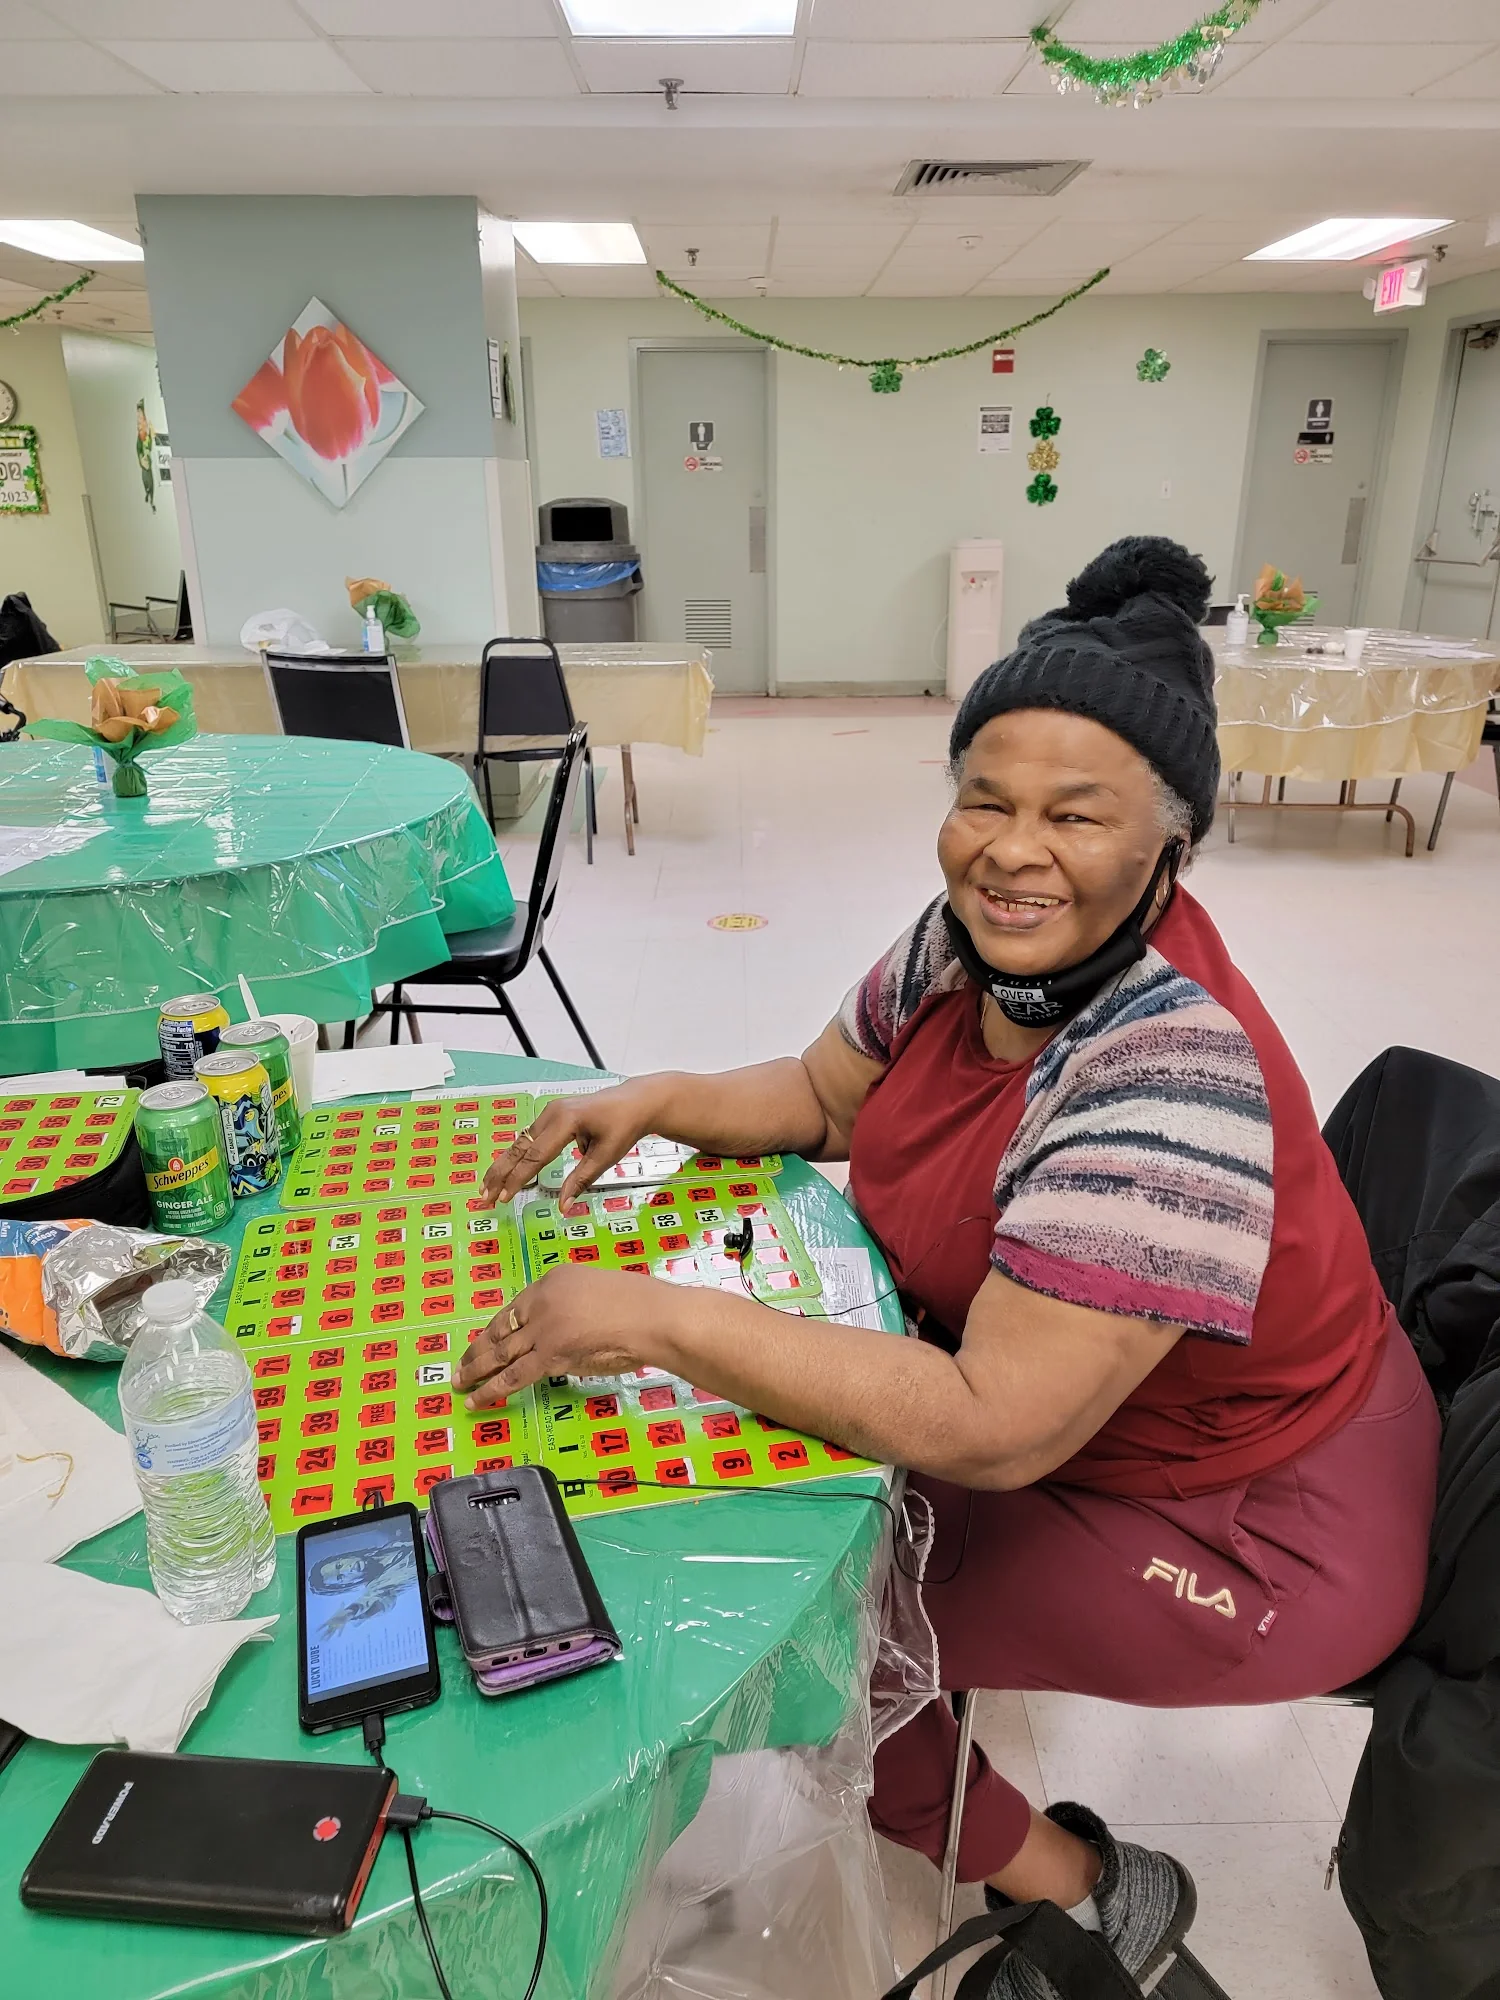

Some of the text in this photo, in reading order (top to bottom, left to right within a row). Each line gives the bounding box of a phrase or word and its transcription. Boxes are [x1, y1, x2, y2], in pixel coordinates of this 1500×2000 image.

[1380, 268, 1404, 306] EXIT
[1, 491, 29, 502] 2023
[1000, 989, 1035, 1001] OVER
[101, 1096, 119, 1107] 73
[380, 1126, 396, 1136] 51
[459, 1120, 475, 1129] 57
[310, 1132, 325, 1140] G
[305, 1149, 321, 1158] N
[457, 1154, 473, 1164] 28
[22, 1157, 44, 1169] 30
[331, 1164, 349, 1175] 25
[374, 1161, 391, 1171] 19
[415, 1156, 432, 1168] 30
[153, 1158, 209, 1189] Schweppes
[455, 1172, 472, 1183] 15
[551, 1169, 564, 1178] B
[294, 1187, 310, 1197] B
[694, 1160, 719, 1222] 54 73 9
[737, 1183, 755, 1198] 65
[156, 1195, 214, 1210] GINGER ALE
[474, 1219, 492, 1233] 58
[615, 1221, 633, 1233] 51
[652, 1193, 680, 1249] FREE 58 63
[257, 1224, 275, 1235] O
[535, 1208, 559, 1265] N G O
[476, 1240, 493, 1254] 42
[571, 1224, 594, 1261] 37 46
[621, 1241, 638, 1255] 44
[252, 1246, 271, 1258] G
[428, 1203, 449, 1309] 2 21 31 57 70
[327, 1213, 357, 1324] 6 27 37 54 66
[379, 1208, 402, 1319] 15 19 FREE 59 69
[477, 1264, 496, 1279] 24
[248, 1269, 267, 1283] N
[280, 1289, 300, 1305] 16
[479, 1289, 498, 1305] 14
[236, 1323, 256, 1338] B
[371, 1341, 391, 1359] 75
[423, 1335, 443, 1352] 64
[262, 1358, 284, 1376] 71
[423, 1366, 444, 1383] 57
[369, 1371, 390, 1390] 53
[258, 1387, 281, 1407] 59
[423, 1395, 445, 1415] 43
[370, 1404, 384, 1423] FREE
[540, 1383, 556, 1451] EASY-READ FINGER-TIP
[553, 1404, 575, 1422] N
[301, 1349, 338, 1506] 7 24 39 49 62
[480, 1421, 503, 1443] 30
[657, 1423, 680, 1445] 24
[423, 1430, 448, 1451] 16
[595, 1398, 633, 1493] 10 17 34
[709, 1417, 745, 1470] 9 21
[365, 1439, 388, 1461] 25
[558, 1444, 579, 1454] I
[777, 1448, 800, 1461] 2
[665, 1467, 688, 1478] 6
[564, 1479, 586, 1498] B
[1143, 1557, 1237, 1619] FILA
[1257, 1609, 1275, 1632] FILA
[309, 1644, 321, 1689] LUCKY DUBE
[92, 1781, 134, 1845] POWERADD
